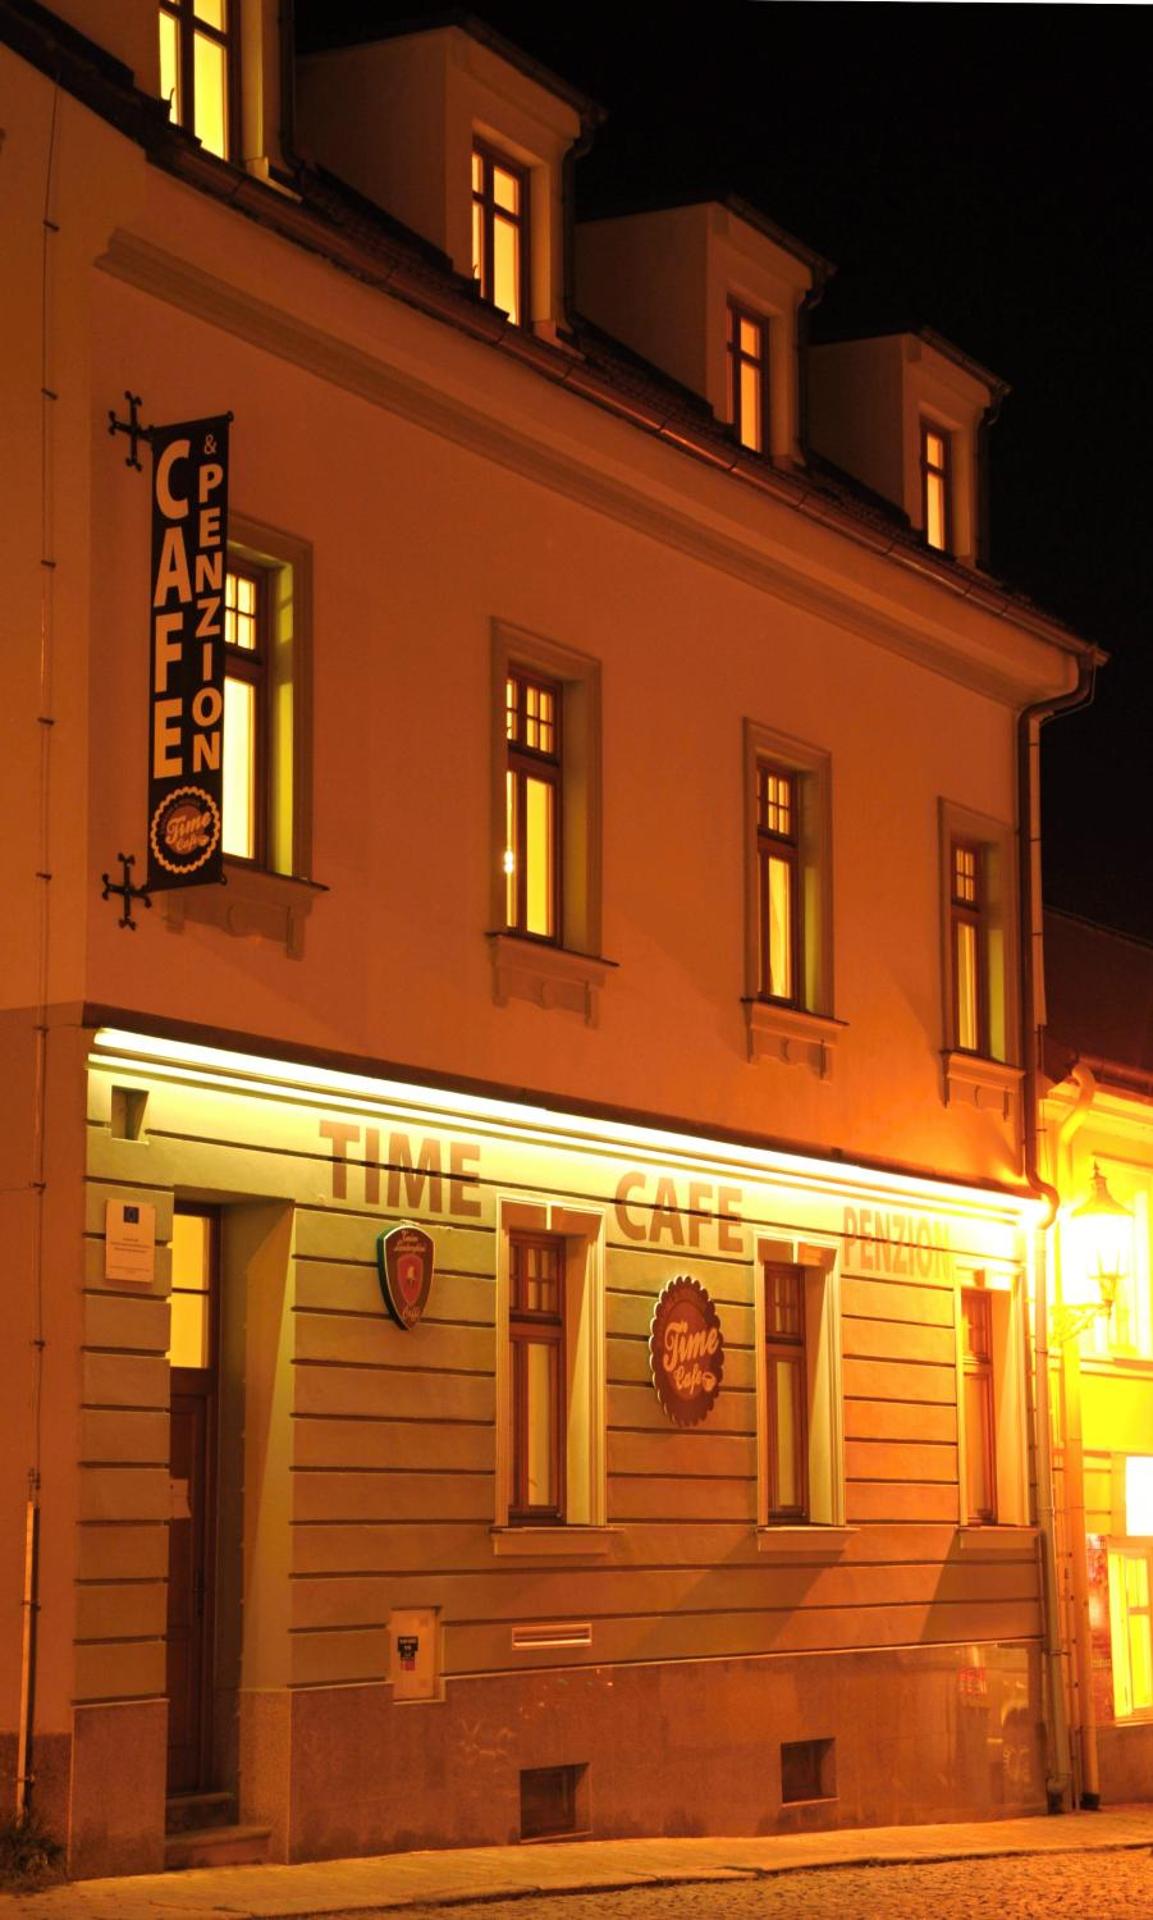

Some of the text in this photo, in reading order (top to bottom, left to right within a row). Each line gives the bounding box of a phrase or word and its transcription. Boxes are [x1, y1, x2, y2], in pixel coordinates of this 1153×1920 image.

[153, 439, 193, 780] CAFE
[191, 433, 224, 774] & PENZION
[165, 811, 211, 845] Time
[319, 1120, 953, 1281] TIME CAFE PENZION
[663, 1320, 719, 1372] Time
